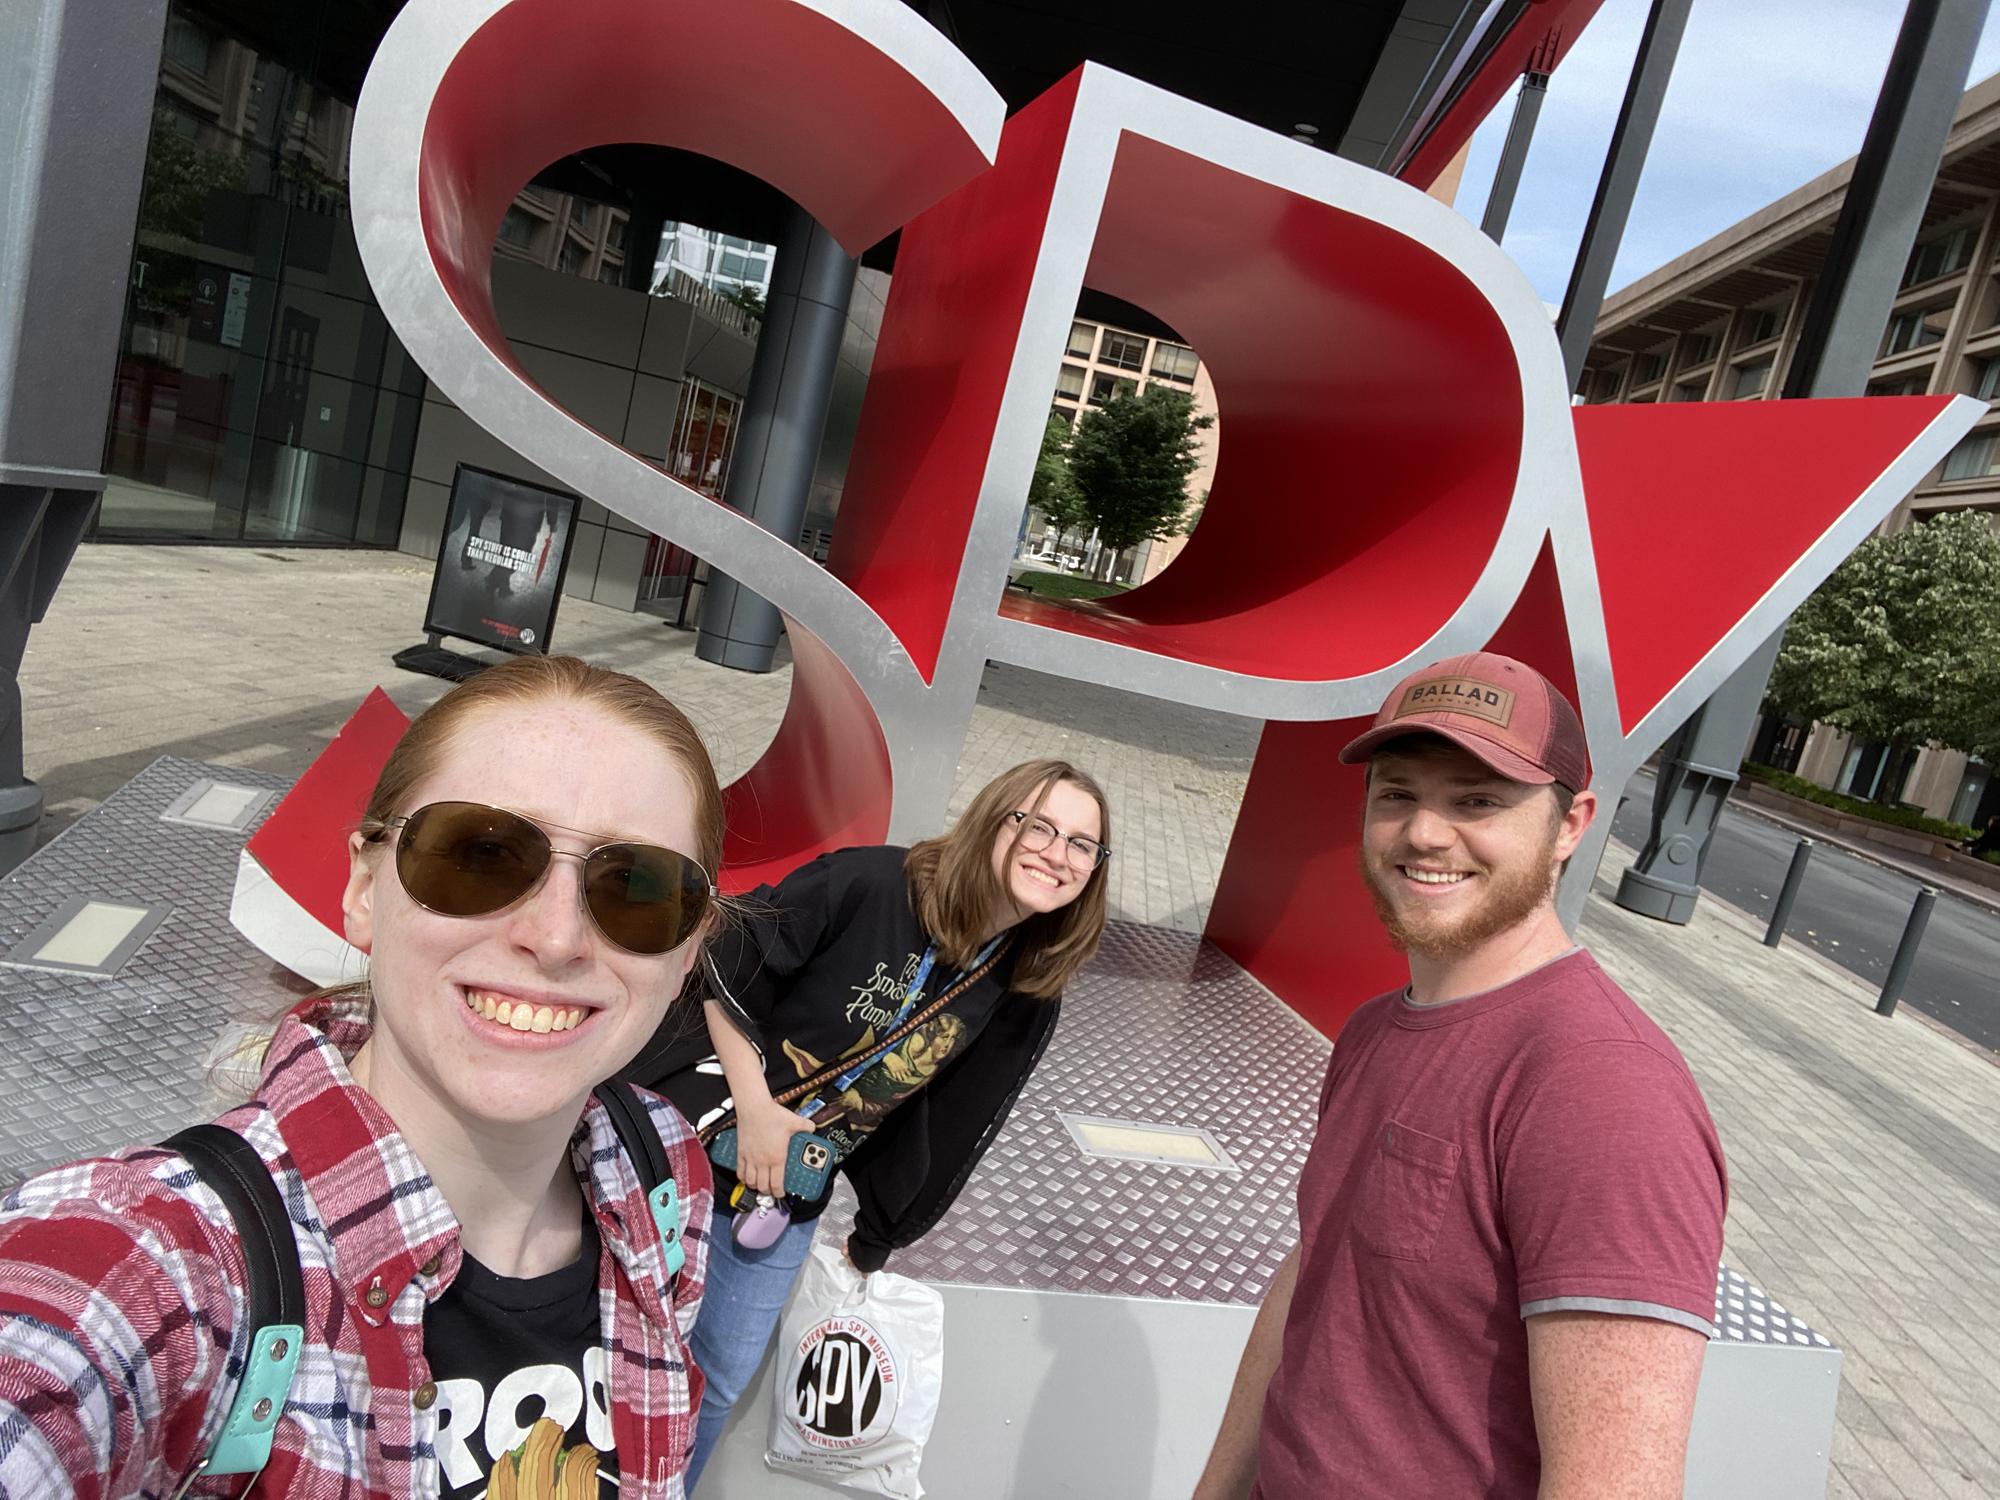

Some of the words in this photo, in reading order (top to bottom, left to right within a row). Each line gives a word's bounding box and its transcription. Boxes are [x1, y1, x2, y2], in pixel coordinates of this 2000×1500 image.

[230, 0, 1986, 985] SPY
[467, 546, 485, 560] THAN
[484, 551, 514, 569] REGULAR
[470, 536, 484, 548] SPY
[484, 540, 503, 554] STUFF
[503, 546, 512, 557] IS
[511, 548, 537, 564] COOLER
[1411, 684, 1499, 706] BALLAD
[899, 952, 921, 982] Th
[847, 1320, 868, 1337] SPY
[866, 1335, 894, 1385] MUSEUM
[796, 1336, 877, 1437] SPY
[794, 1421, 851, 1449] WASHINGTON
